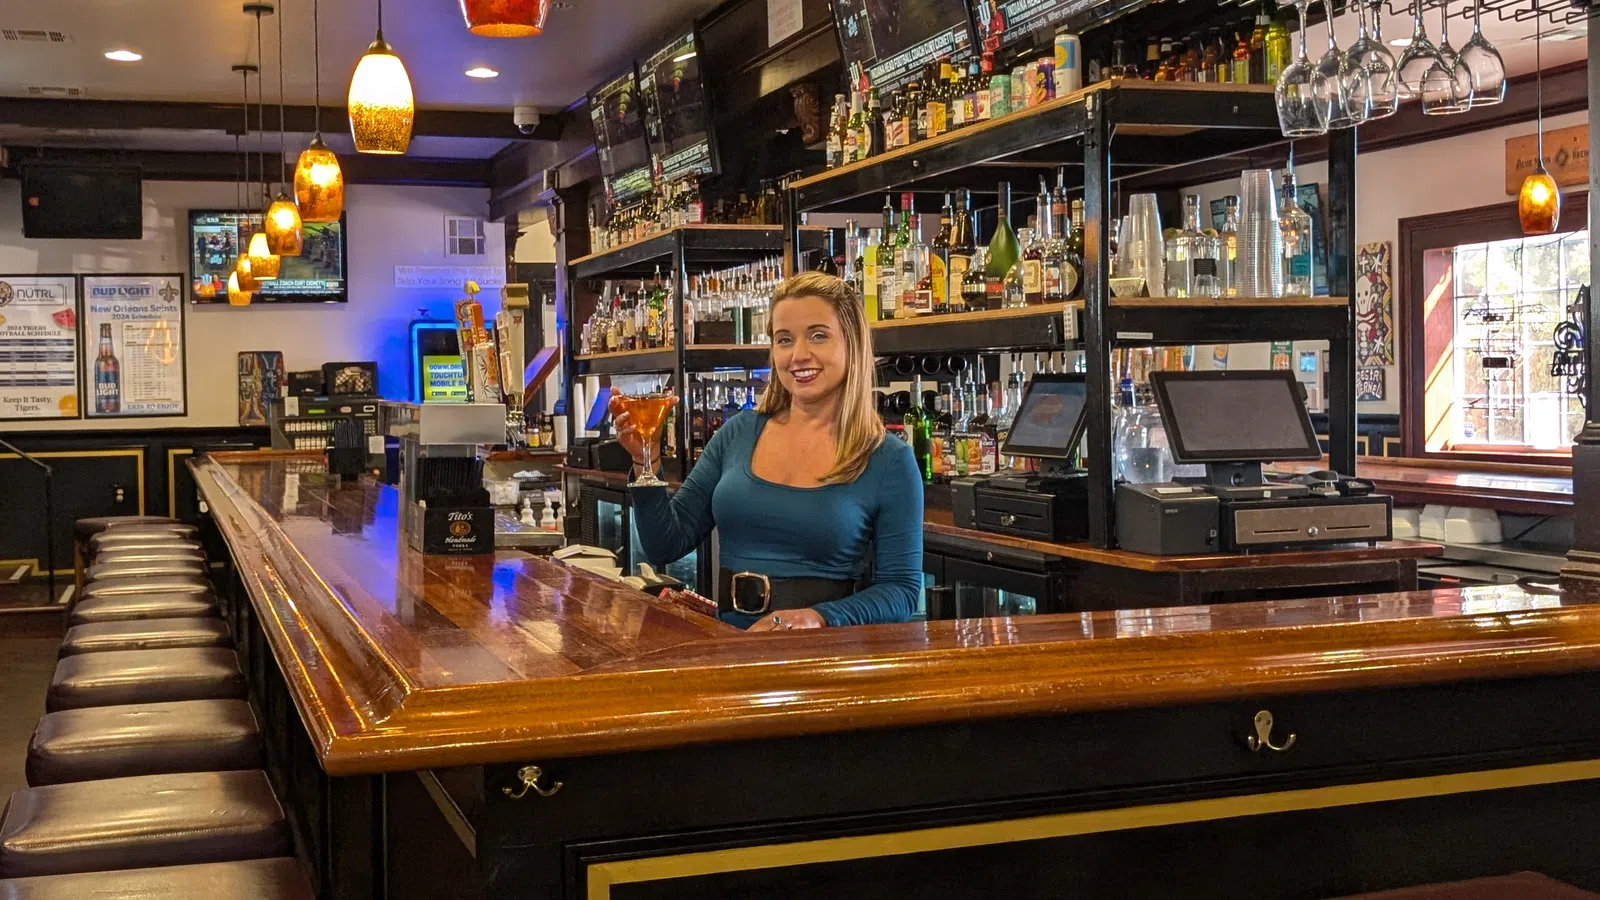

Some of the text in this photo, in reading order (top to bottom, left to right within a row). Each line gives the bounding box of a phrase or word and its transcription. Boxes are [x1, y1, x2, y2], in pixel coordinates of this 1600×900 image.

[92, 287, 151, 296] BUD LIGHT
[448, 512, 473, 521] Tito's
